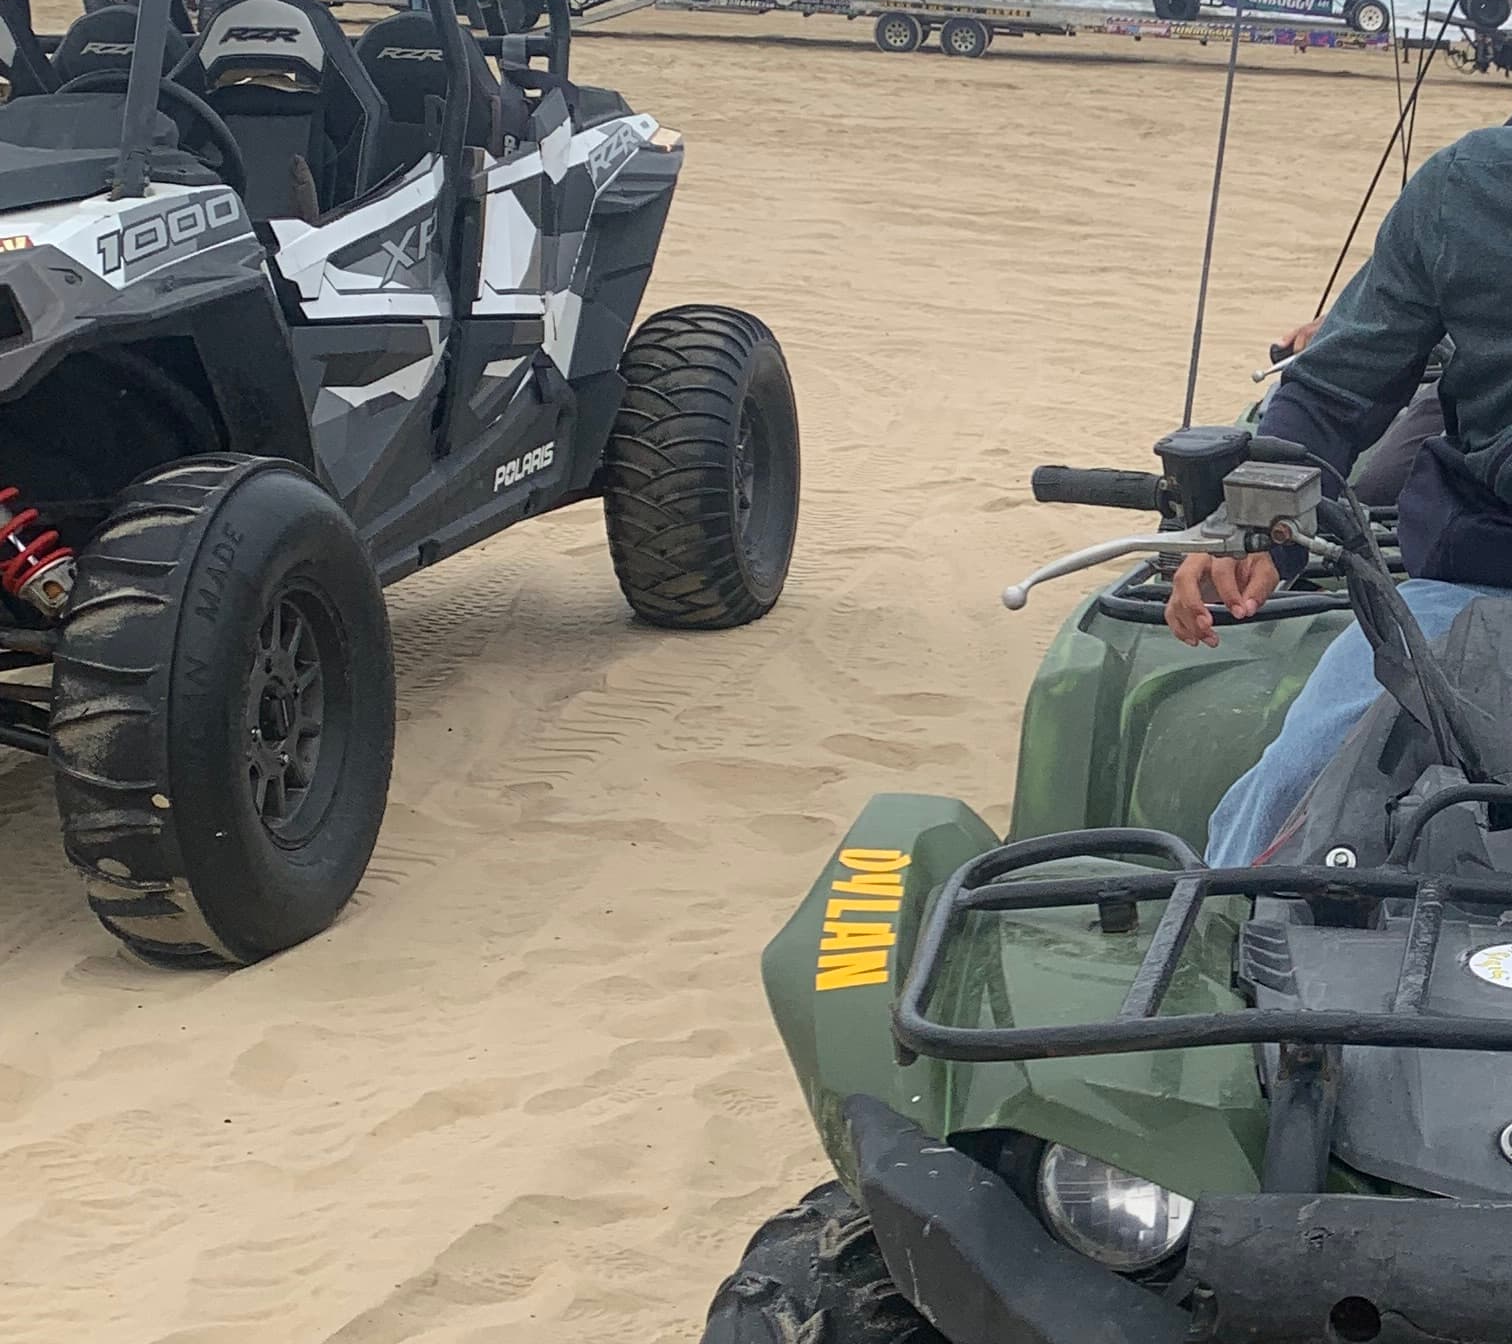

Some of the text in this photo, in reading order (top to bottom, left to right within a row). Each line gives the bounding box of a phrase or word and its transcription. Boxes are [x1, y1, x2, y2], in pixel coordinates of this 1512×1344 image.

[219, 27, 300, 45] RZR
[376, 47, 444, 62] RZR
[591, 126, 640, 179] RZR
[97, 192, 241, 276] 1000
[493, 441, 555, 493] POLARIS
[816, 847, 913, 992] DYLAN
